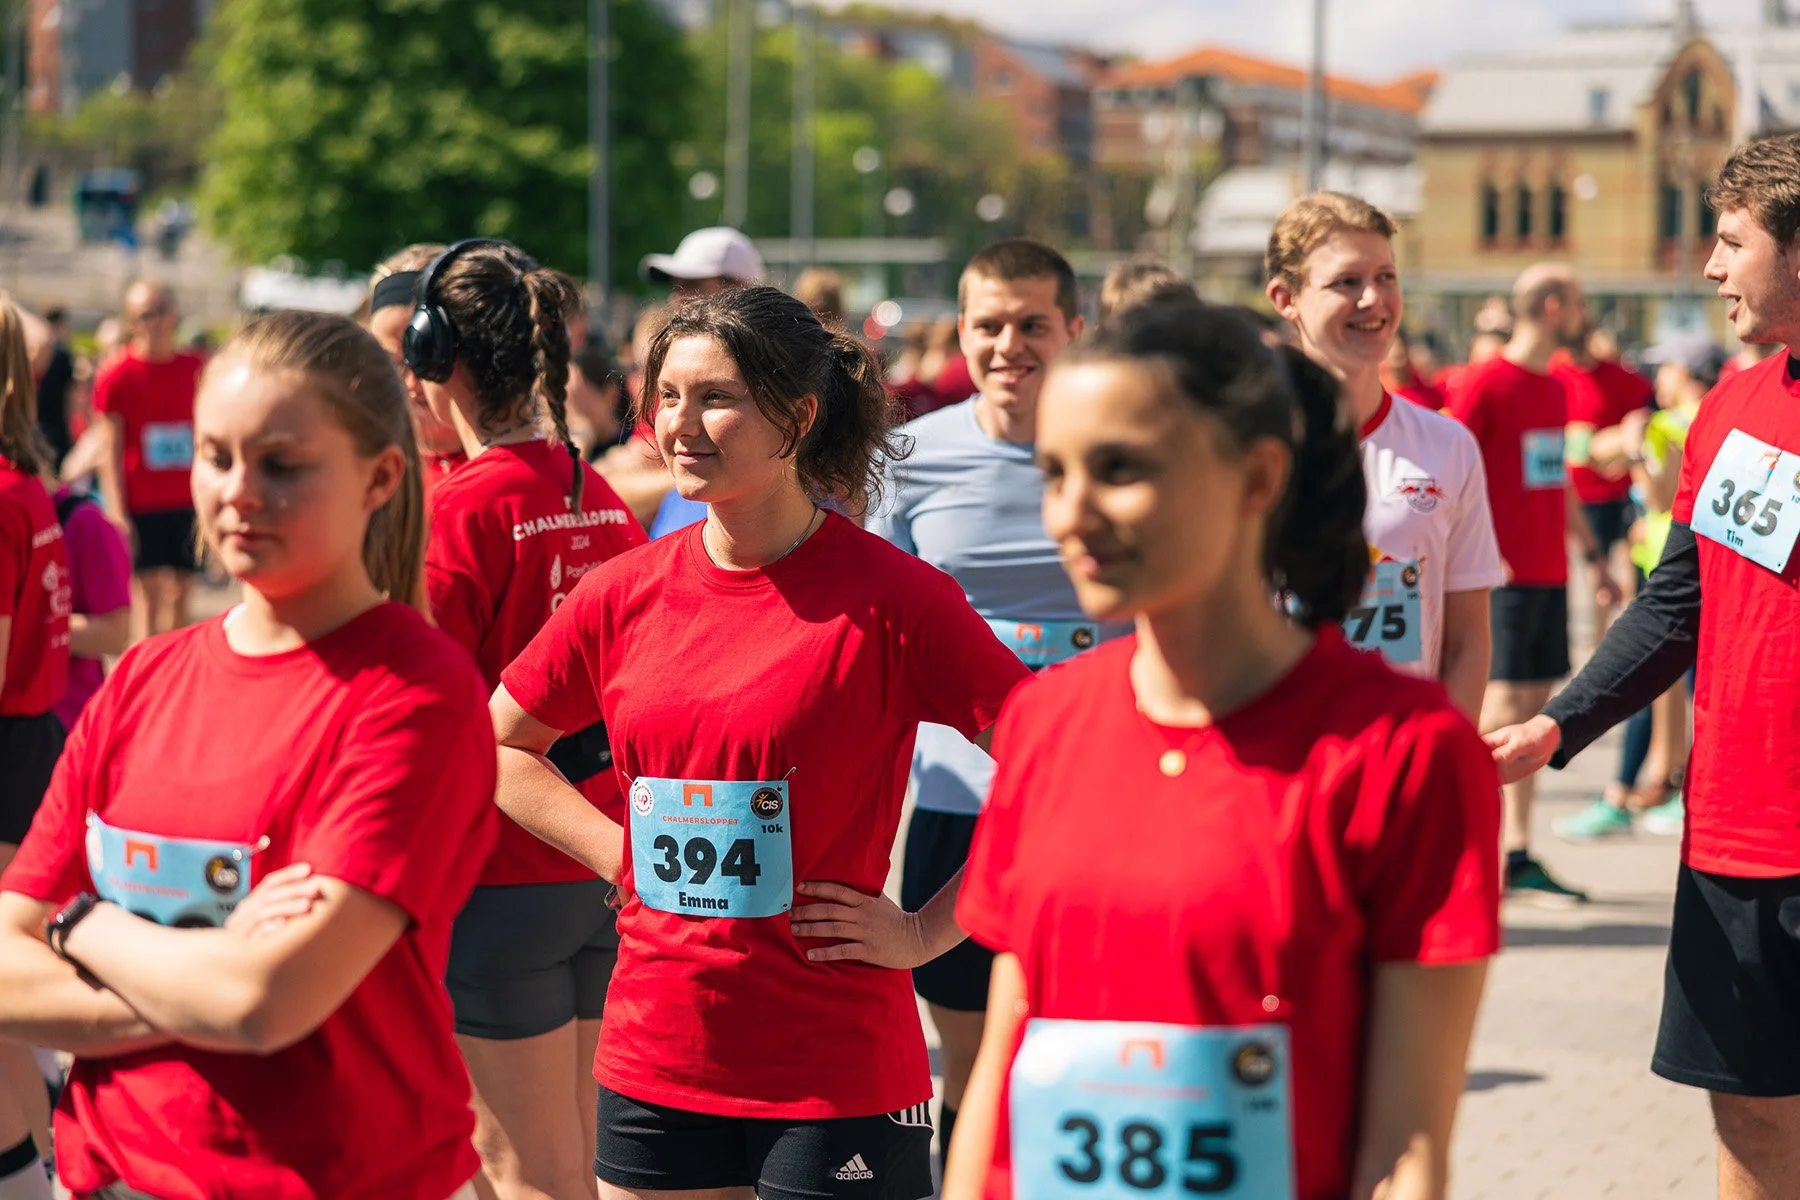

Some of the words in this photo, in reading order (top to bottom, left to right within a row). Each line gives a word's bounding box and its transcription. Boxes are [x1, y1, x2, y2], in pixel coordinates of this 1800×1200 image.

[1711, 479, 1784, 537] 365
[1726, 529, 1744, 547] Tim
[1341, 604, 1406, 643] 75
[761, 800, 779, 810] CIS
[662, 815, 740, 825] CHALMERSLOPPET
[761, 823, 784, 834] 10k
[653, 834, 761, 886] 394
[678, 891, 729, 910] Emma
[1059, 1116, 1239, 1194] 385
[835, 1170, 874, 1180] adidas
